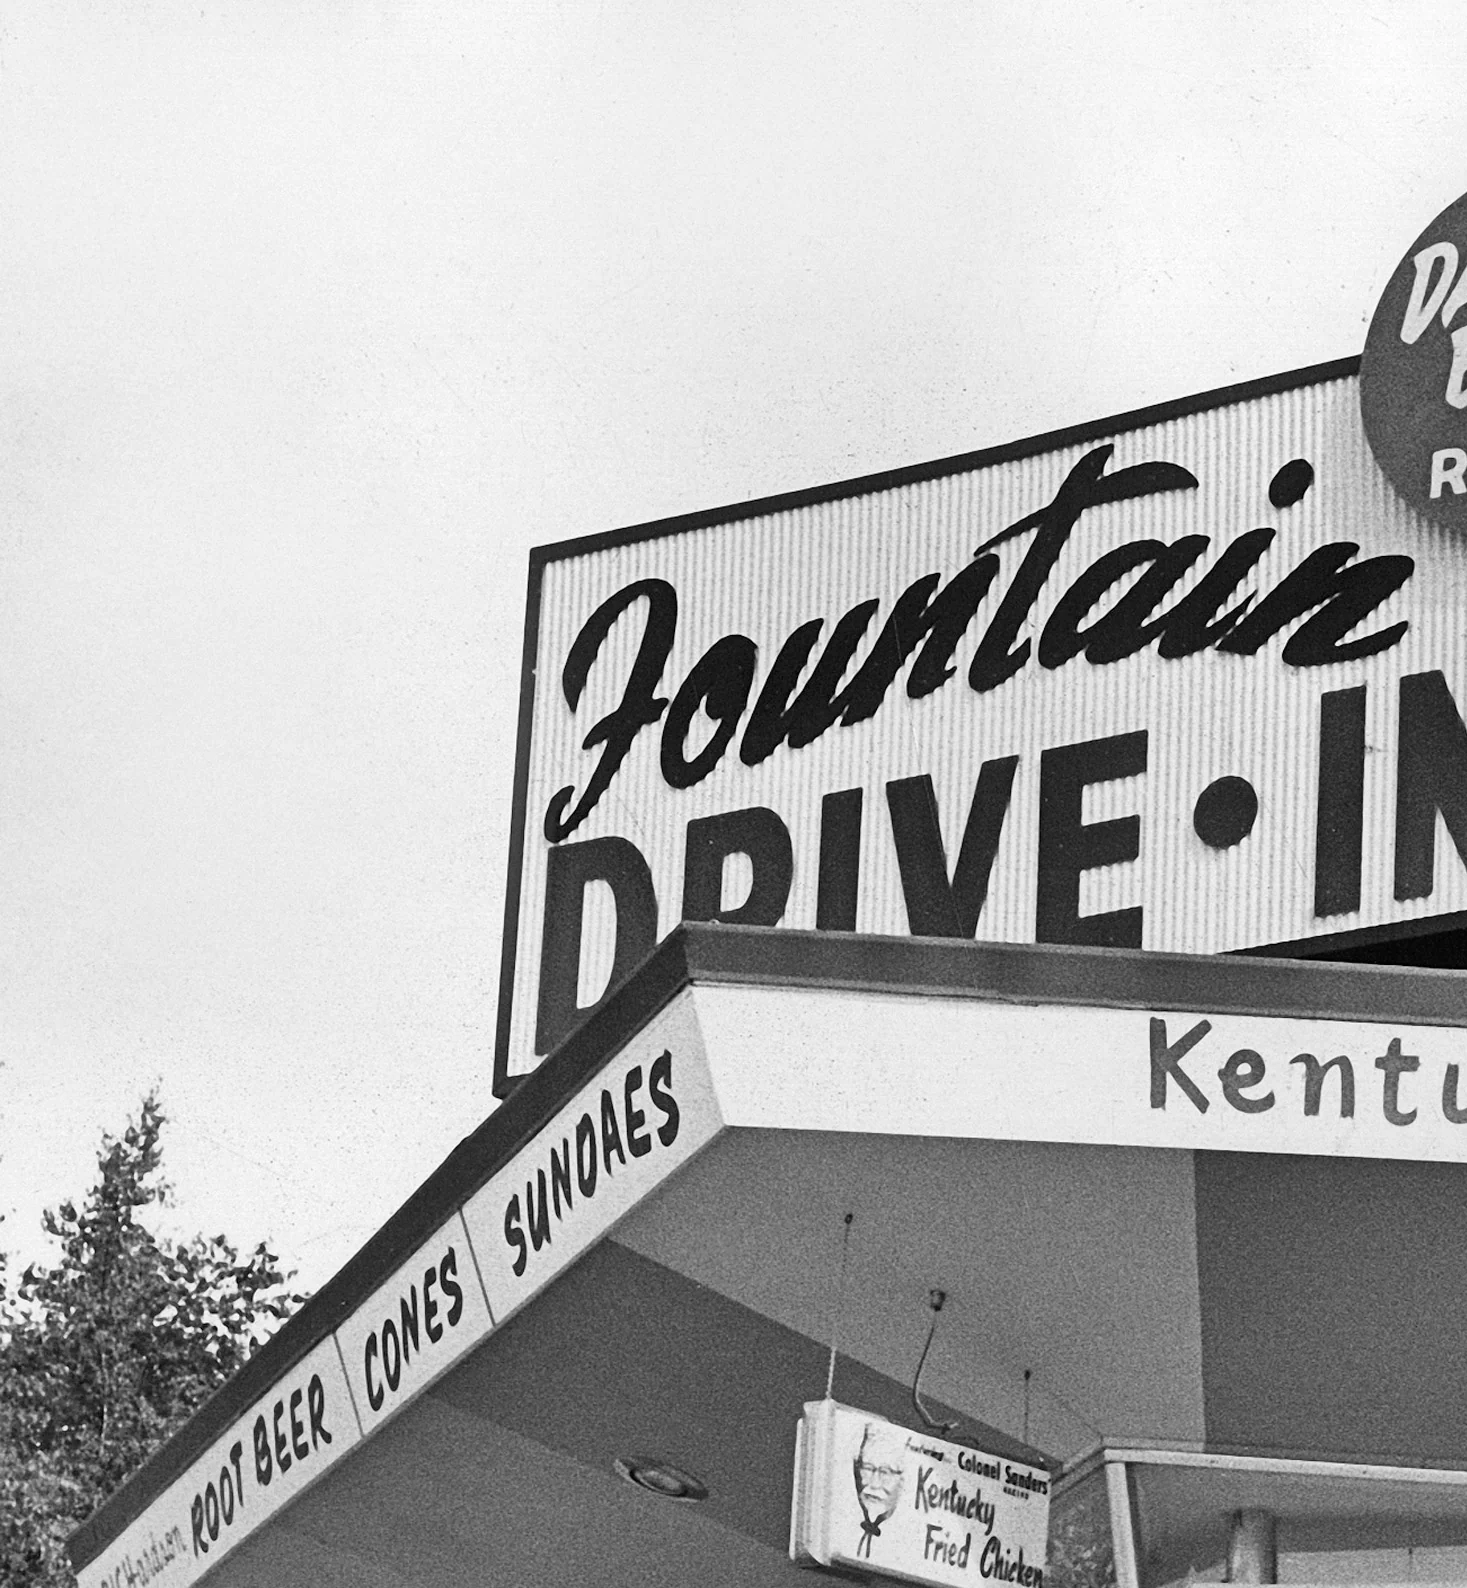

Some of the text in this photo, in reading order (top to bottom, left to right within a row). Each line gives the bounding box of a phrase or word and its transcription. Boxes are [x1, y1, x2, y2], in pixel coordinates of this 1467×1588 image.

[543, 443, 1414, 844] Fountain
[503, 1049, 681, 1276] SUNDAES
[363, 1246, 464, 1413] CONES
[191, 1440, 244, 1559] ROOT
[253, 1373, 333, 1487] BEER
[914, 1465, 996, 1536] Kentucky
[923, 1523, 972, 1568] Fried
[957, 1451, 1001, 1481] Colonel
